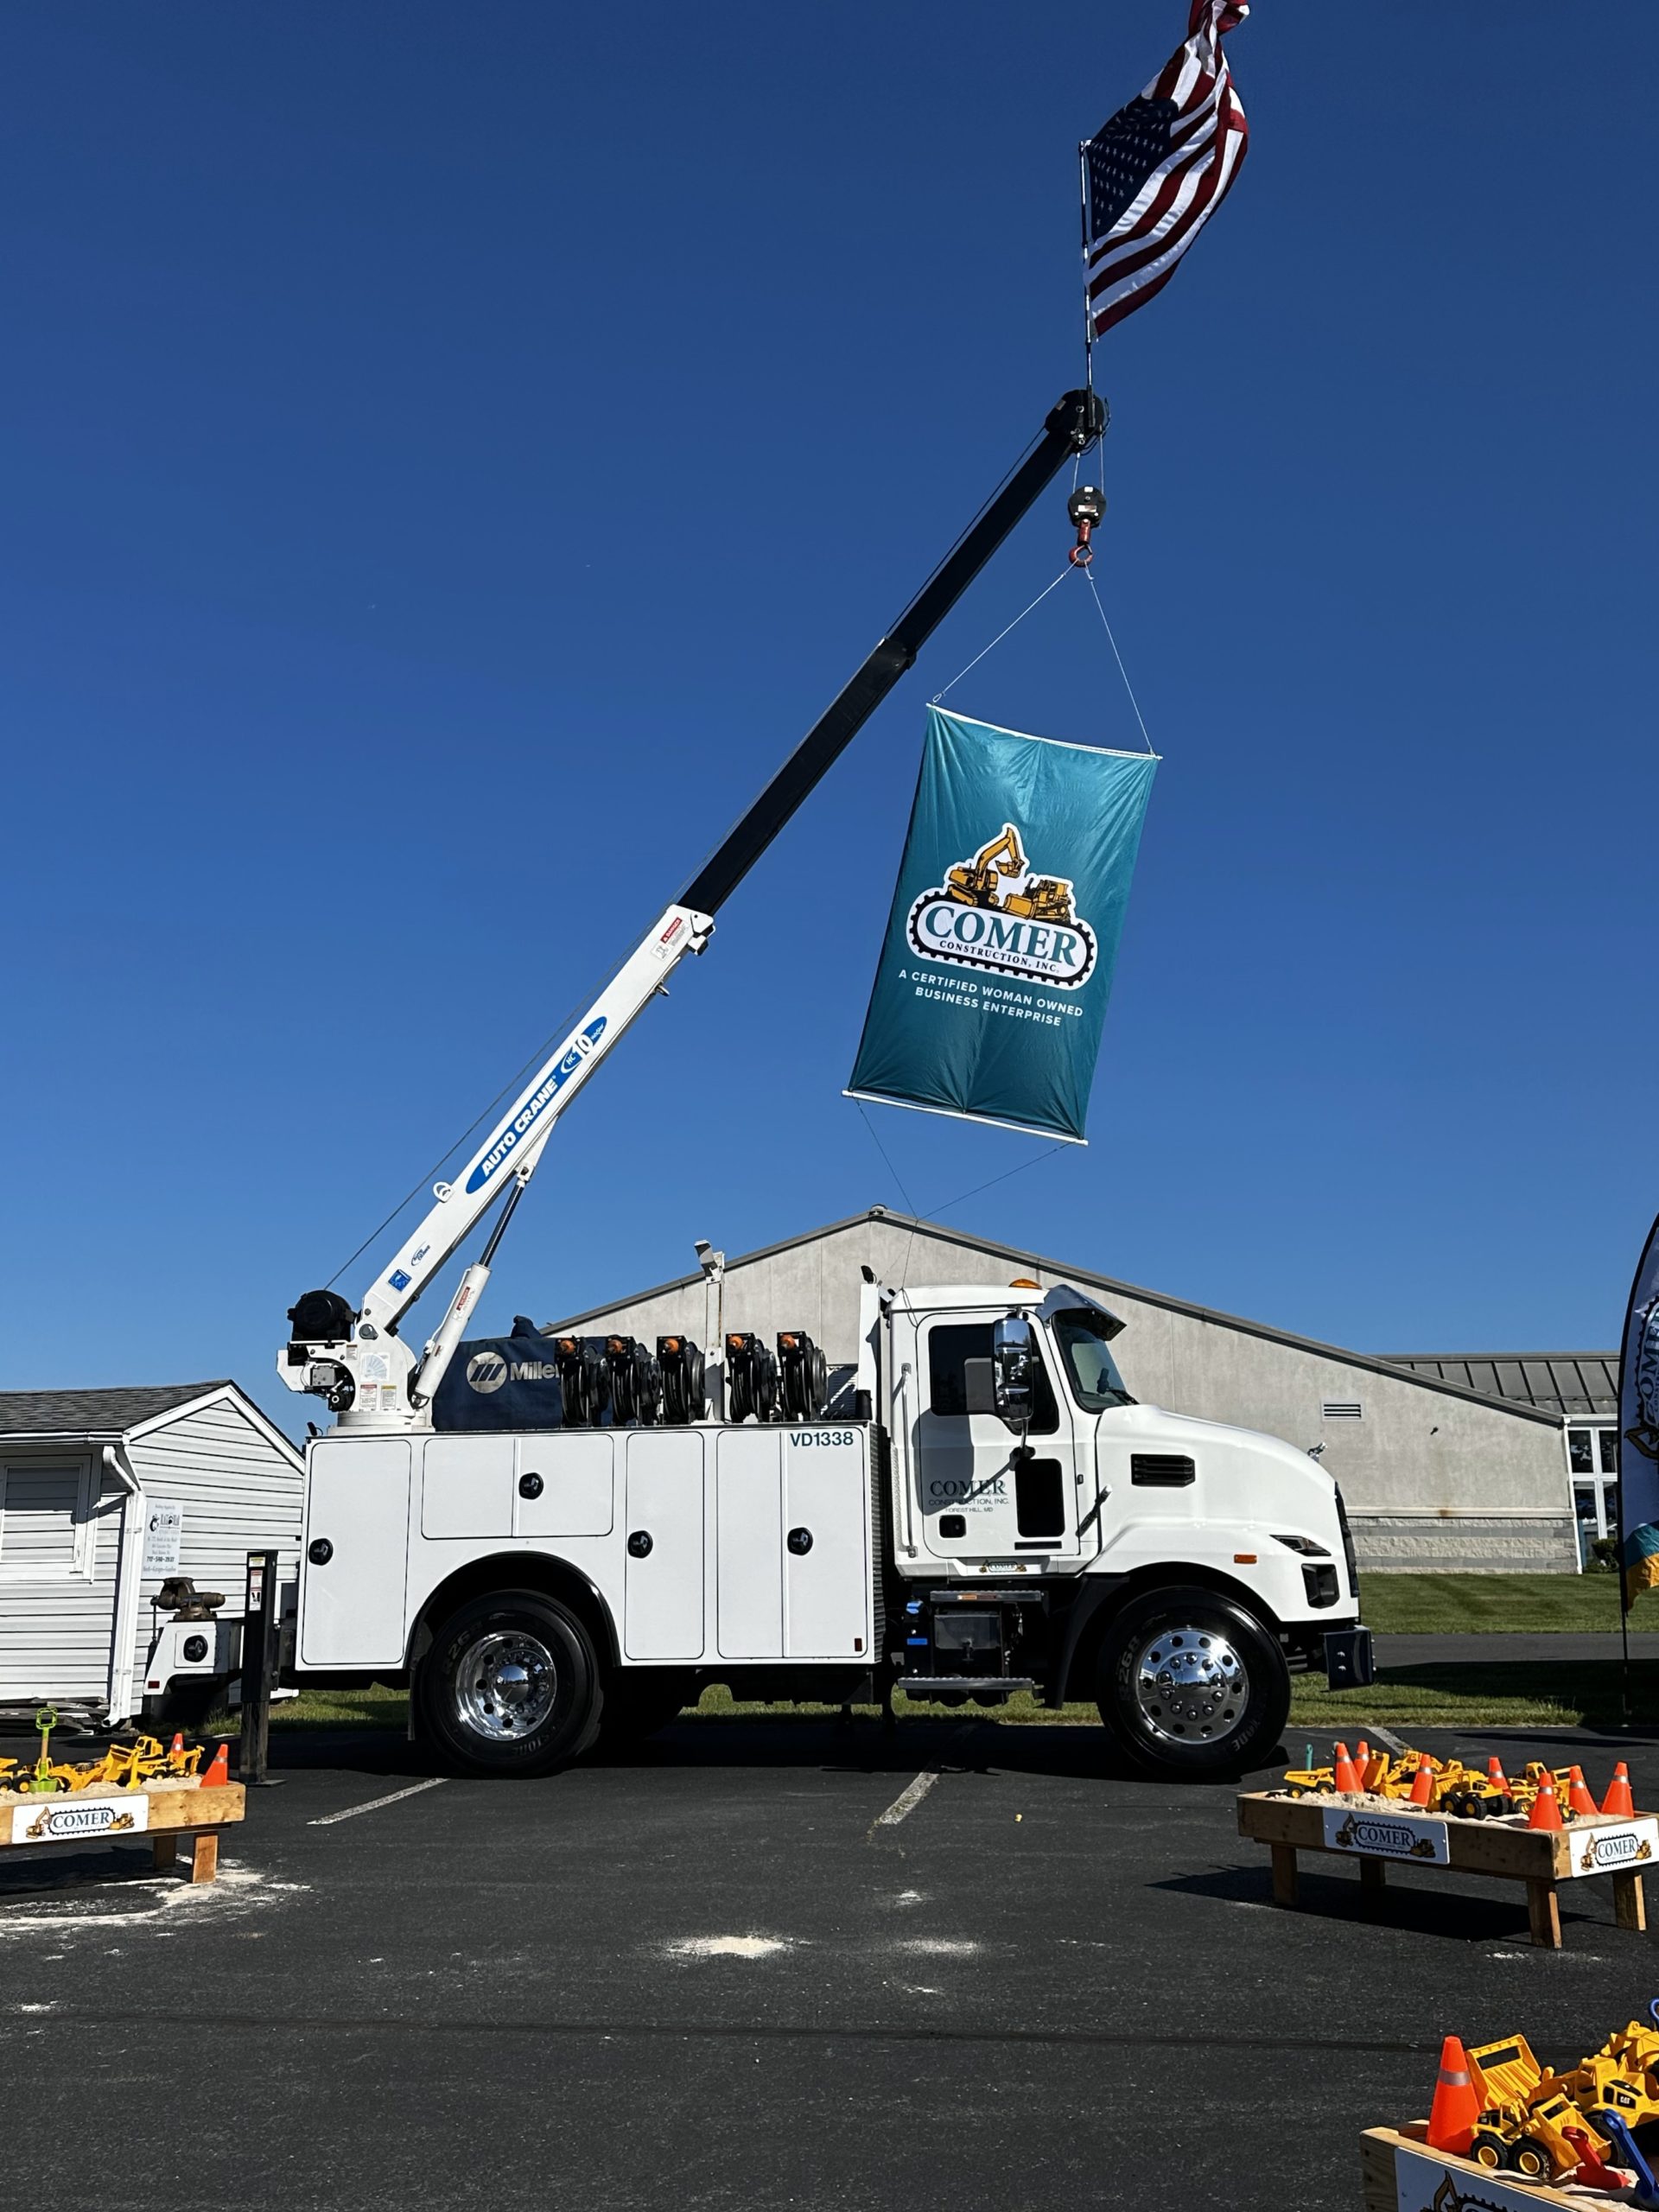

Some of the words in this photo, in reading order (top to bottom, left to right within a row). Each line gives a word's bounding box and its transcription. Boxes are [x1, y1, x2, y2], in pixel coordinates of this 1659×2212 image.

[925, 906, 1076, 967] COMER
[939, 940, 1032, 968] CONSTRUCTION,
[1036, 961, 1060, 974] INC.
[899, 969, 907, 979] A
[912, 971, 978, 993] CERTIFIED
[982, 986, 1033, 1005] WOMAN
[1037, 998, 1084, 1017] OWNED
[915, 986, 979, 1008] BUSINESS
[982, 1001, 1062, 1027] ENTERPRISE
[572, 1033, 594, 1059] 10
[481, 1132, 517, 1177] AUTO
[514, 1077, 558, 1133] CRANE
[790, 1431, 854, 1446] VD1338
[931, 1479, 1007, 1497] COMER
[53, 1812, 110, 1828] COMER
[1358, 1826, 1411, 1847] COMER
[1599, 1838, 1637, 1858] COMER
